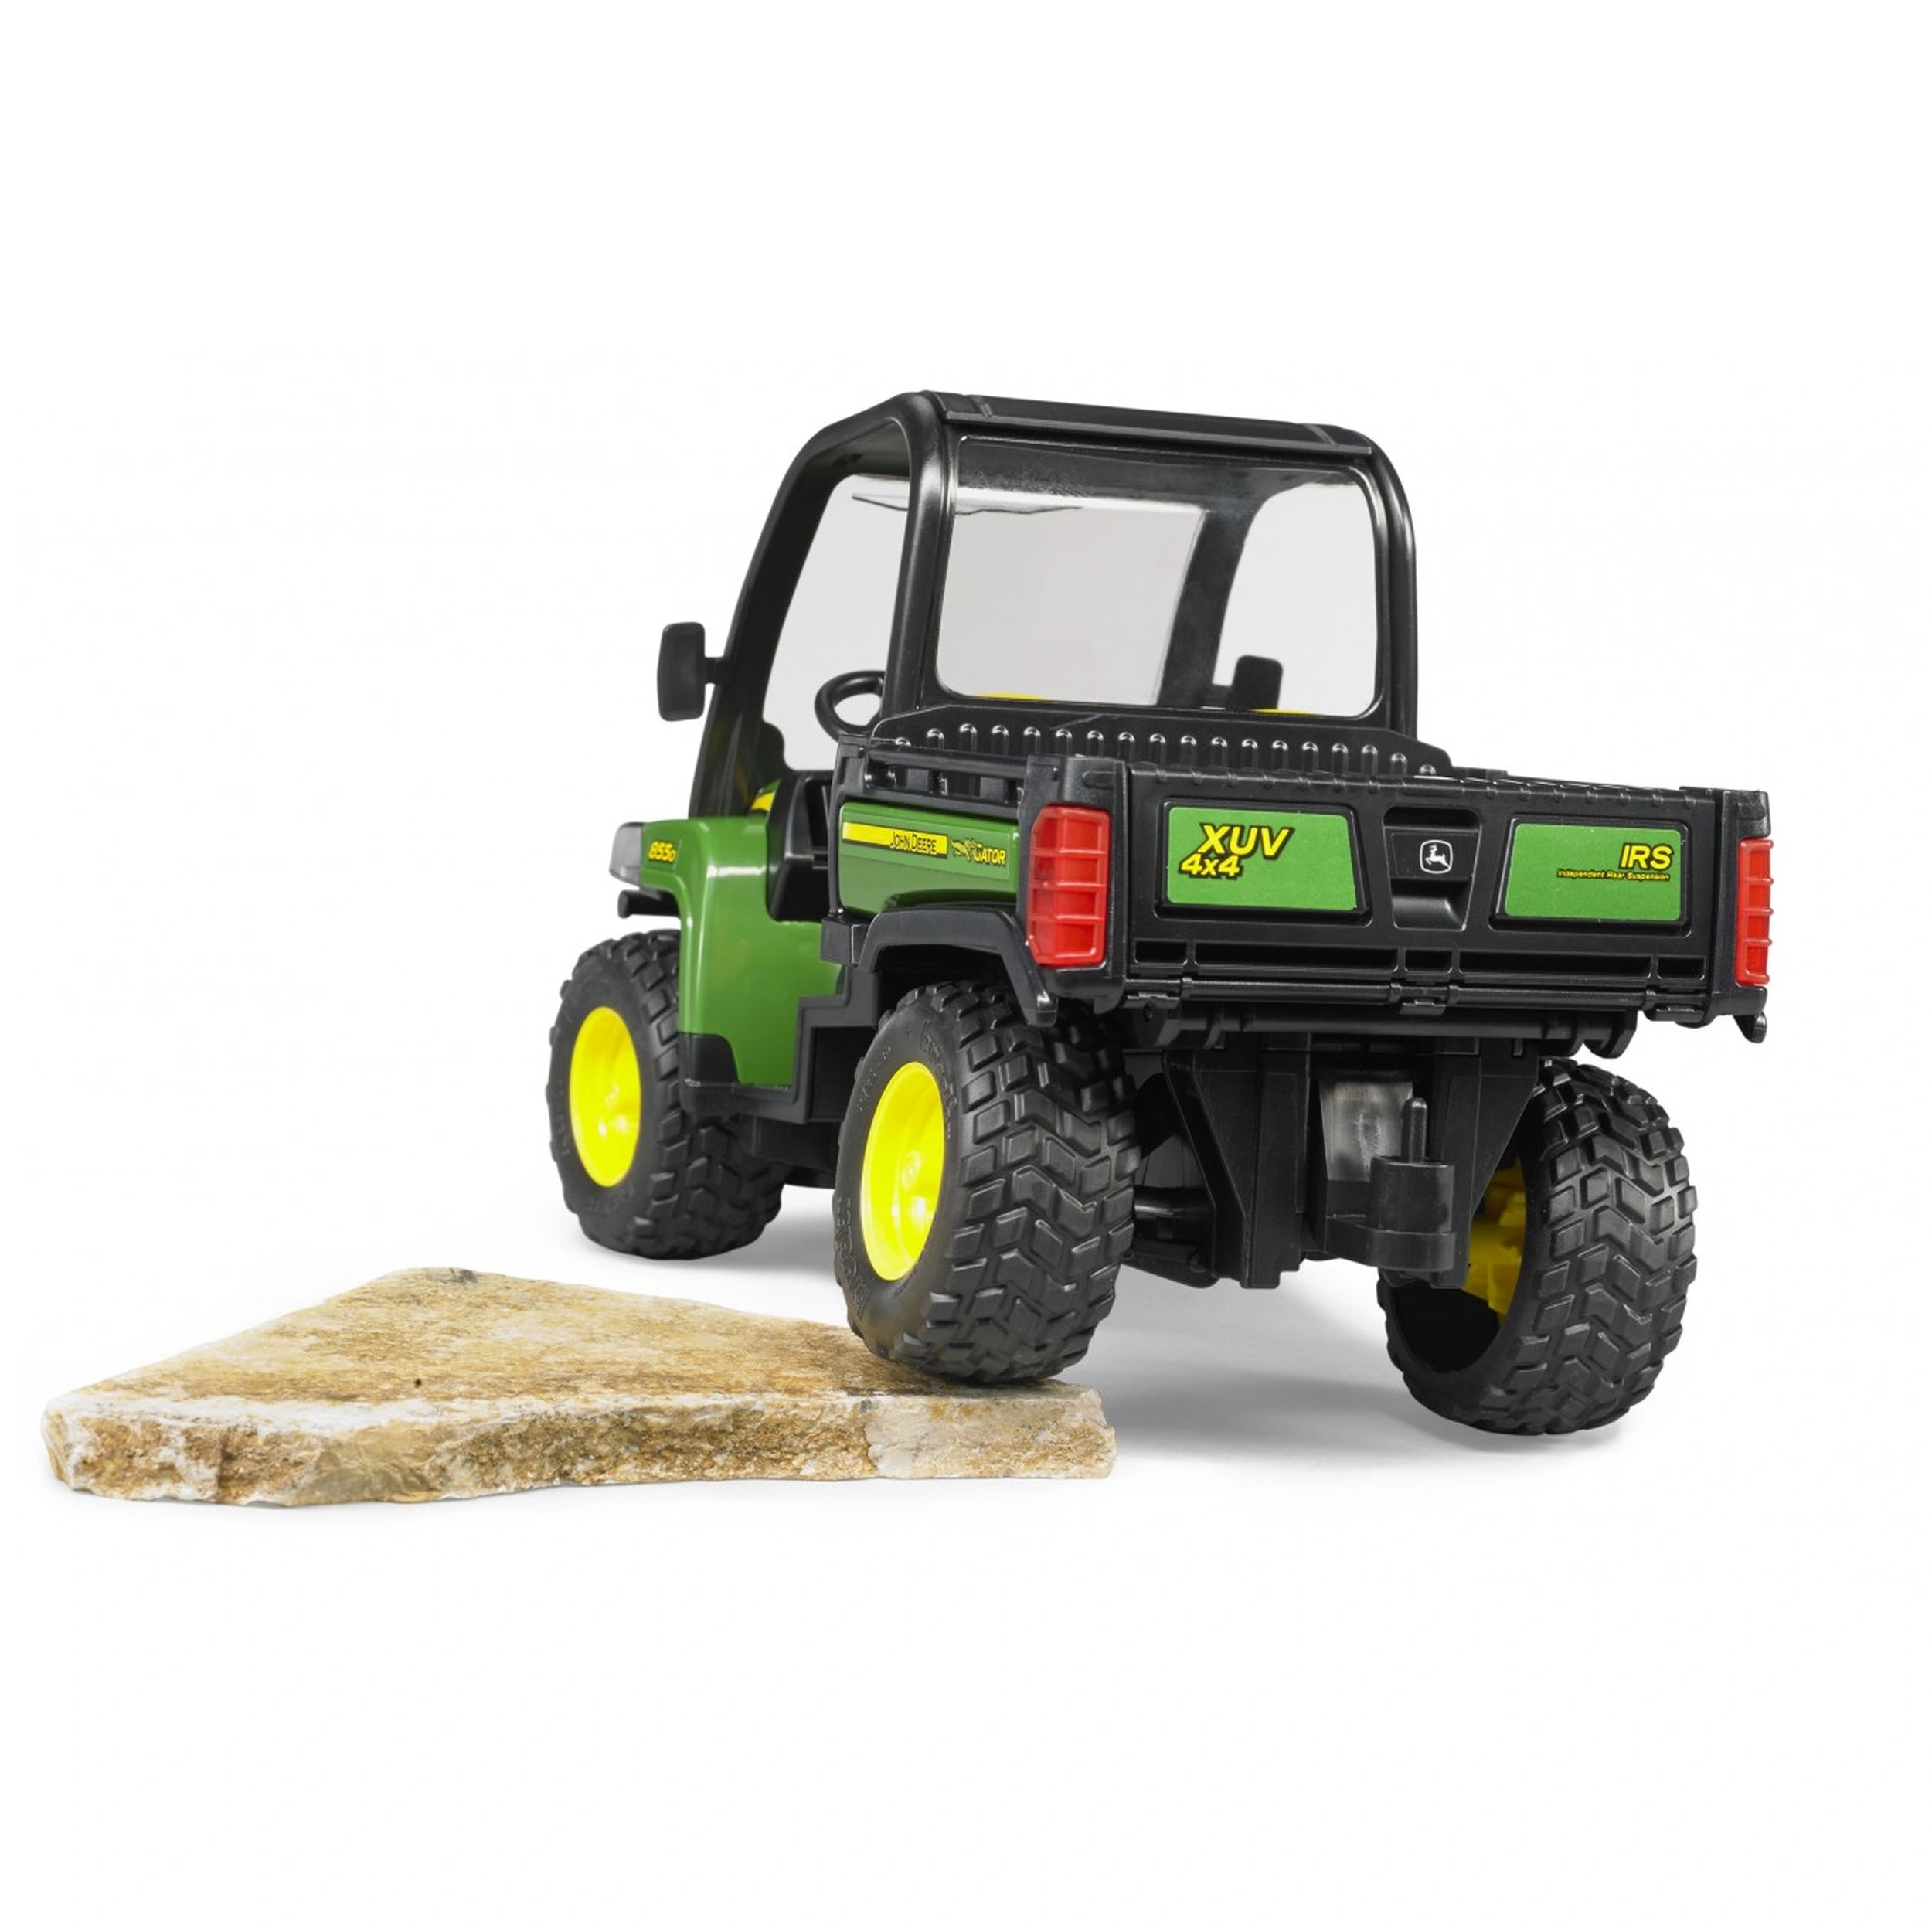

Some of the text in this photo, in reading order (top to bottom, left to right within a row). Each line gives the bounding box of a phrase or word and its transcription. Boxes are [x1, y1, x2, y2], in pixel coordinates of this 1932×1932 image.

[889, 831, 937, 854] JOHN DEERE
[1196, 823, 1292, 858] XUV
[974, 846, 1007, 865] GATOR
[1179, 852, 1242, 877] 4x4
[1620, 844, 1675, 870] IRS
[1557, 869, 1670, 882] Independent Rear Suspension
